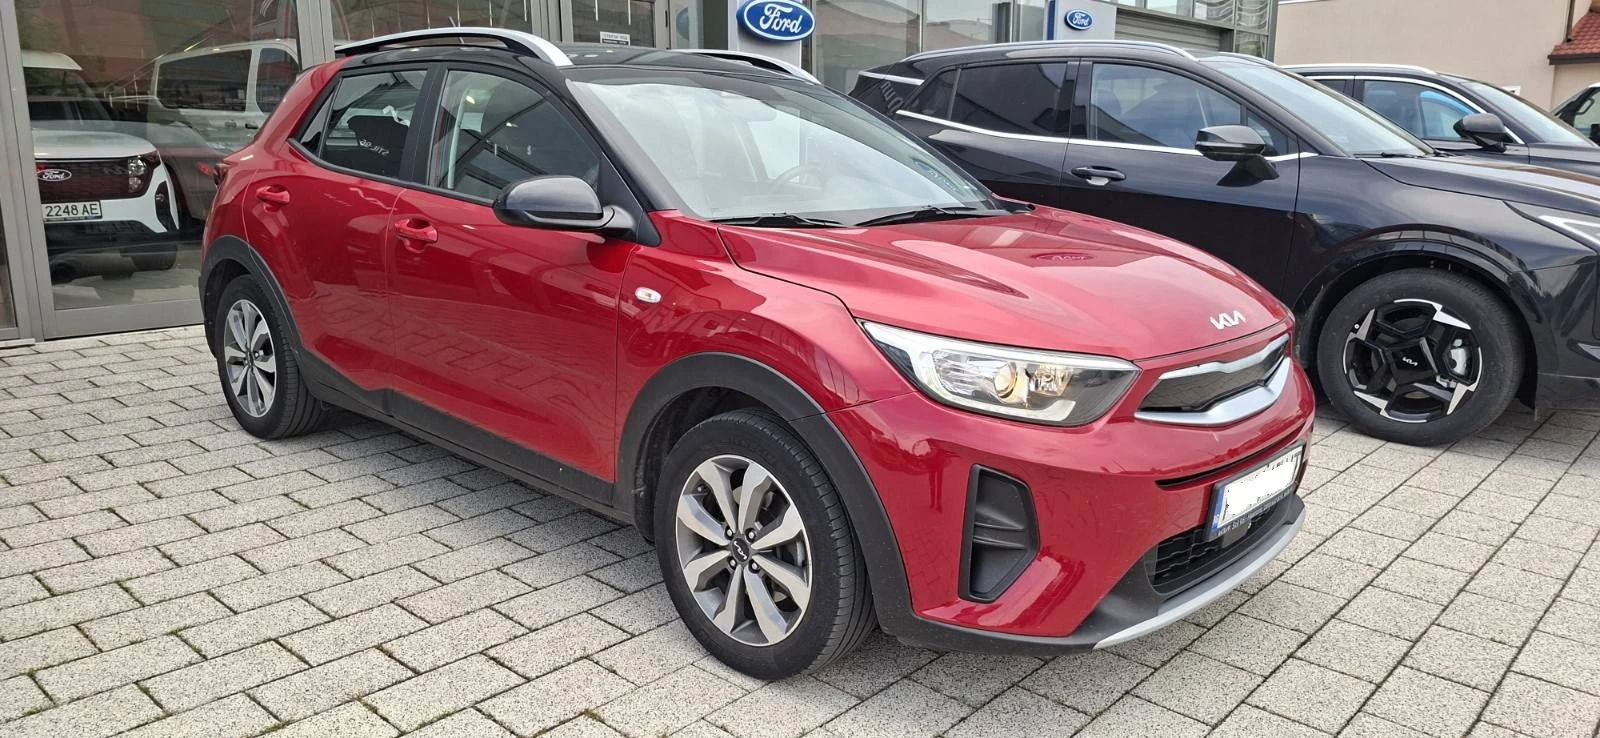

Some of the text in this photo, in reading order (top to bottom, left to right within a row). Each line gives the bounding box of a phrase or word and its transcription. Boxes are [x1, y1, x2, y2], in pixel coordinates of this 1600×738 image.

[760, 3, 803, 33] Ford
[1072, 12, 1090, 26] Ford
[45, 203, 100, 217] 2248 AE
[1209, 310, 1247, 330] KIA
